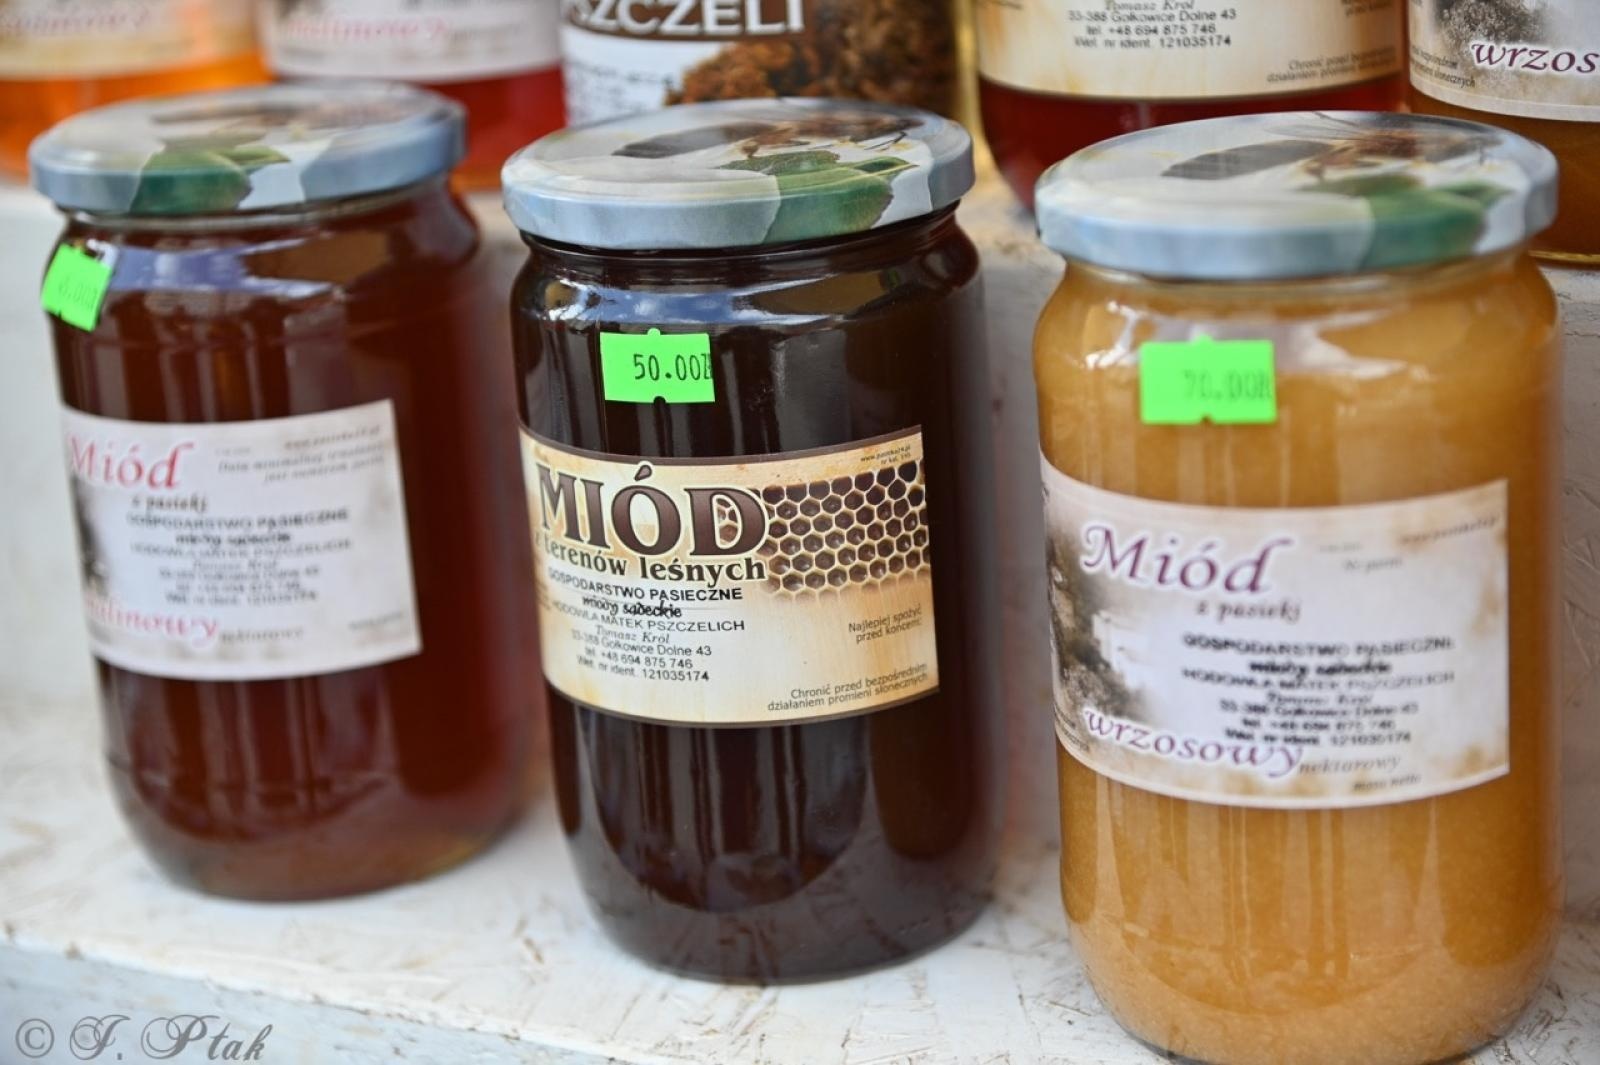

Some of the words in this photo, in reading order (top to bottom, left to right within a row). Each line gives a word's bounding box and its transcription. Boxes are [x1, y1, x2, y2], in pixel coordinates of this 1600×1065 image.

[1179, 8, 1217, 21] Dolne
[1220, 8, 1237, 20] 43
[1163, 25, 1188, 35] 875
[1192, 23, 1216, 34] 746
[1159, 35, 1232, 48] 121035174
[535, 462, 767, 557] MIÓD
[544, 541, 628, 576] terenów
[640, 556, 767, 589] leśnych
[1083, 524, 1294, 594] Miód
[547, 566, 646, 599] GOSPODARSTWO
[649, 587, 744, 602] PASIECZNE
[596, 624, 638, 641] Tomasz
[600, 614, 643, 630] MATEK
[648, 619, 746, 633] PSZCZELICH
[848, 614, 891, 634] Najlepiej
[855, 629, 883, 645] przed
[1182, 633, 1349, 656] GOSPODARSTWO
[600, 650, 620, 663] +48
[621, 653, 641, 665] 694
[644, 656, 666, 668] 875
[670, 658, 693, 669] 746
[657, 644, 693, 656] Dolne
[695, 646, 713, 657] 43
[642, 667, 710, 682] 121035174
[790, 683, 831, 699] Chronić
[834, 678, 864, 697] przed
[865, 661, 928, 687] bezpośrednim
[767, 696, 825, 712] działaniem
[828, 688, 873, 707] promieni
[1084, 709, 1305, 778] wrzosowy
